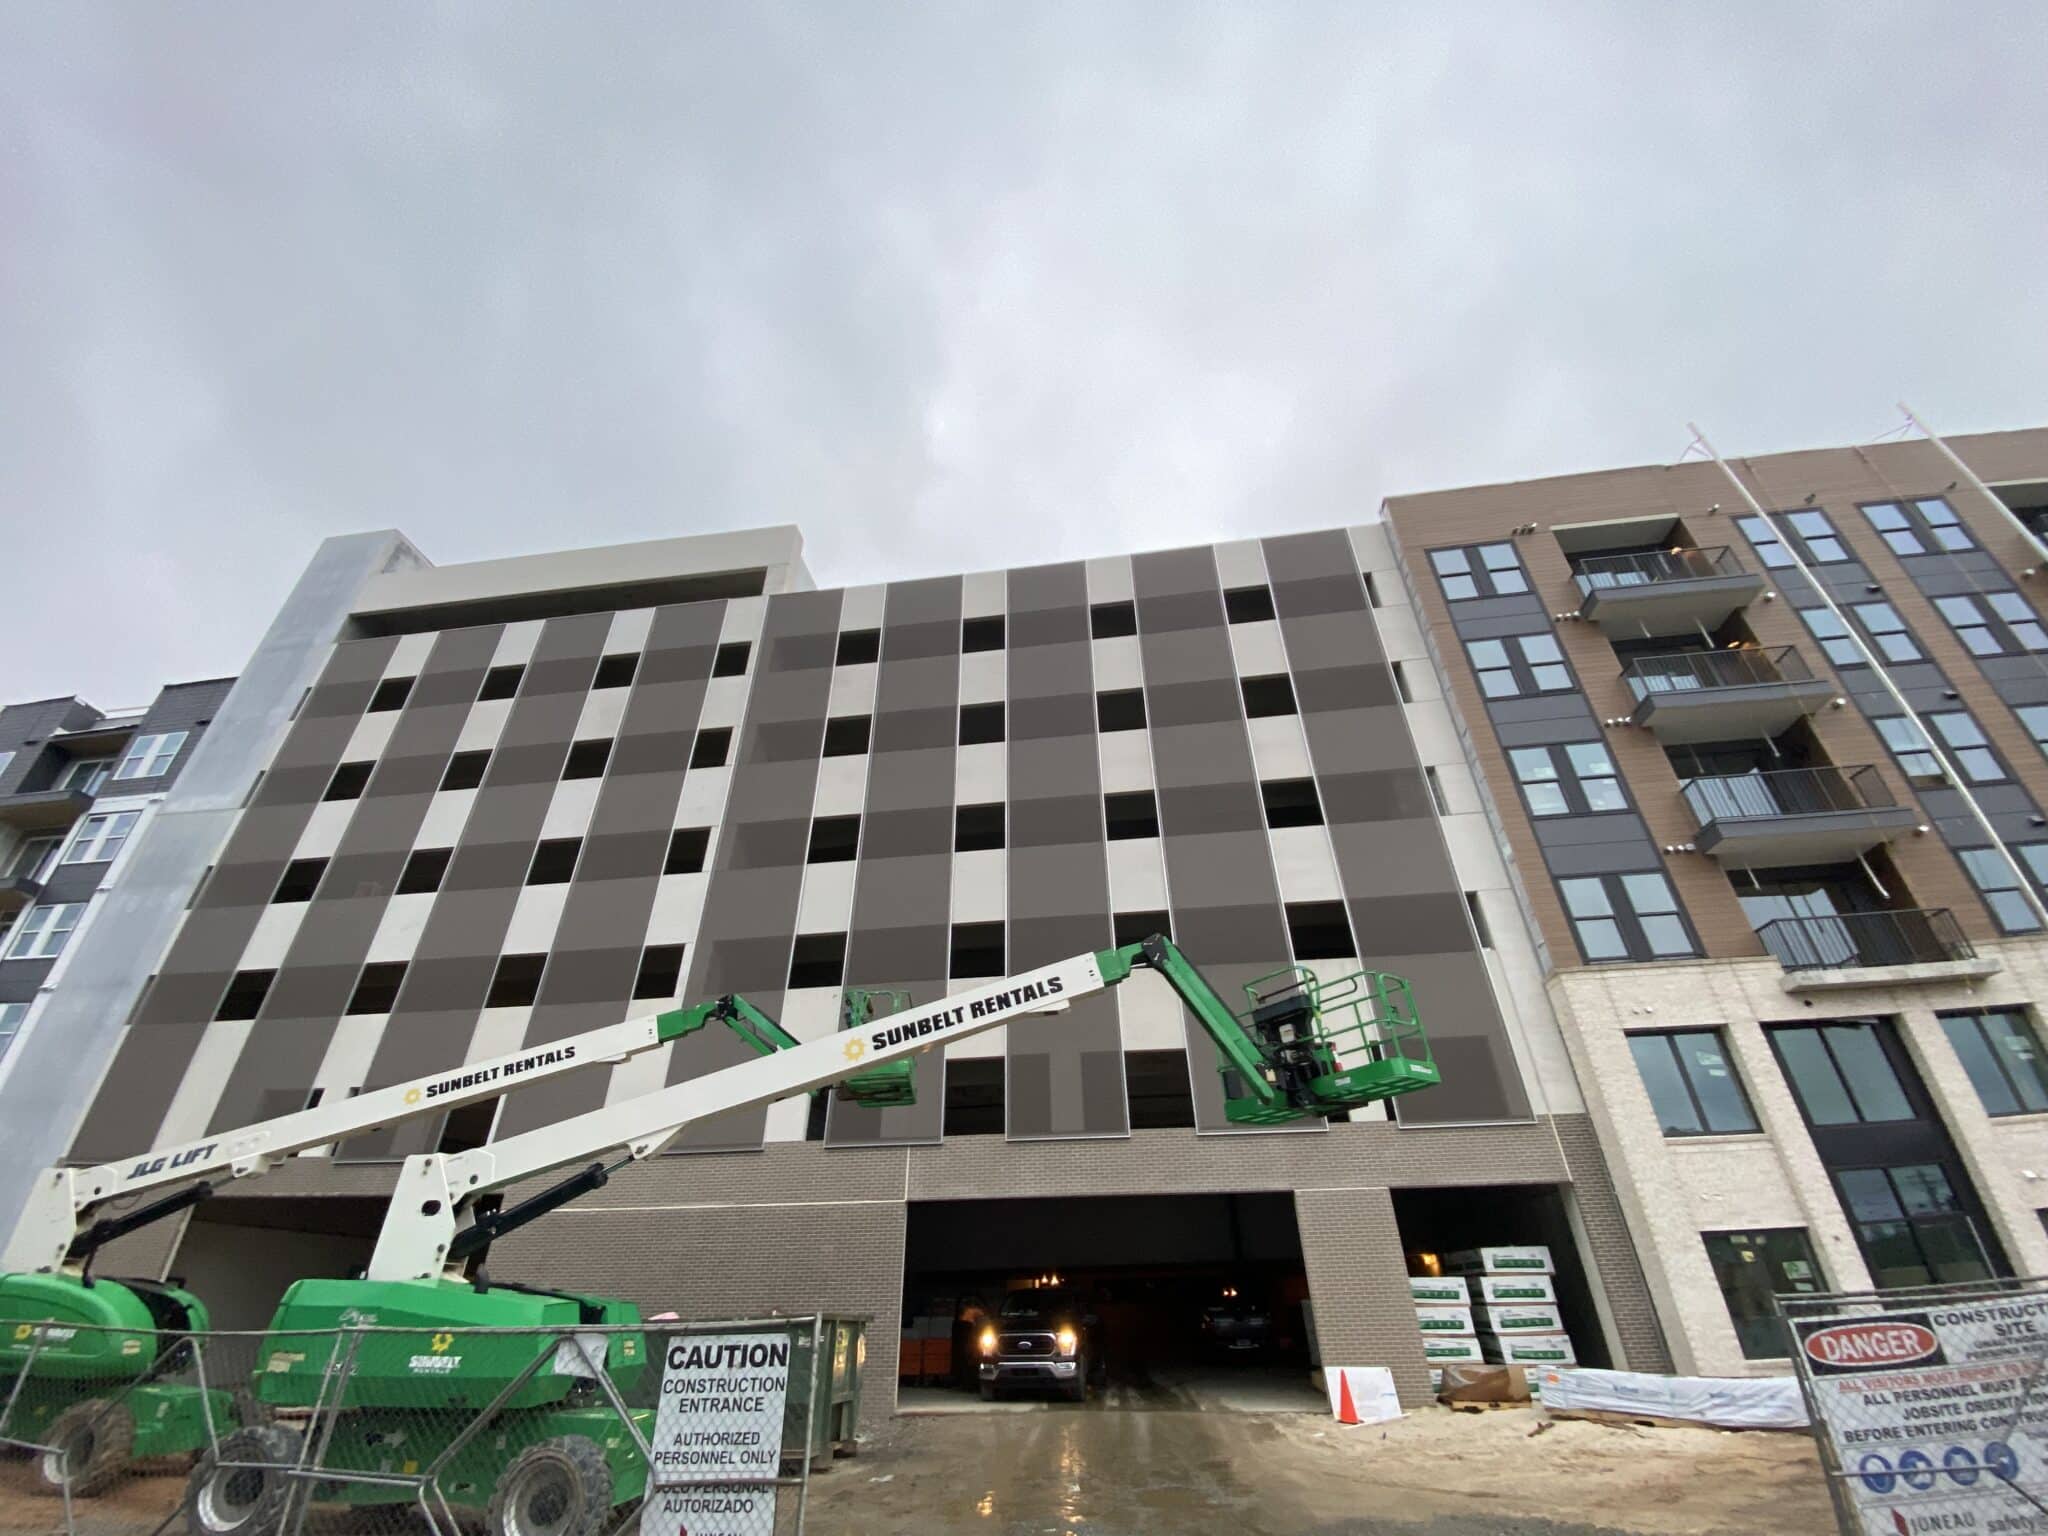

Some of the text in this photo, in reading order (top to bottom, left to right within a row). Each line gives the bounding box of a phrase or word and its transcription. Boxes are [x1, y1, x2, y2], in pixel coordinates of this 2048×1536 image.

[871, 976, 1064, 1051] SUNBELT RENTALS
[426, 1046, 576, 1098] SUNBELT RENTALS
[126, 1143, 219, 1181] JLG LIFT
[1993, 1320, 2037, 1337] SITE
[667, 1343, 788, 1370] CAUTION
[1819, 1328, 1923, 1361] DANGER
[663, 1376, 786, 1394] CONSTRUCTION
[1863, 1393, 1891, 1406] ALL
[1893, 1384, 1979, 1402] PERSONNEL
[1980, 1379, 2016, 1393] MUST
[679, 1396, 765, 1413] ENTRANCE
[1903, 1402, 1963, 1420] JOBSITE
[673, 1431, 761, 1446] AUTHORIZED
[1843, 1426, 1902, 1443] BEFORE
[1904, 1419, 1977, 1438] ENTERING
[654, 1450, 777, 1465] PERSONNEL ONLY
[663, 1499, 754, 1513] AUTORIZADO
[1910, 1511, 1976, 1536] JUNEAU
